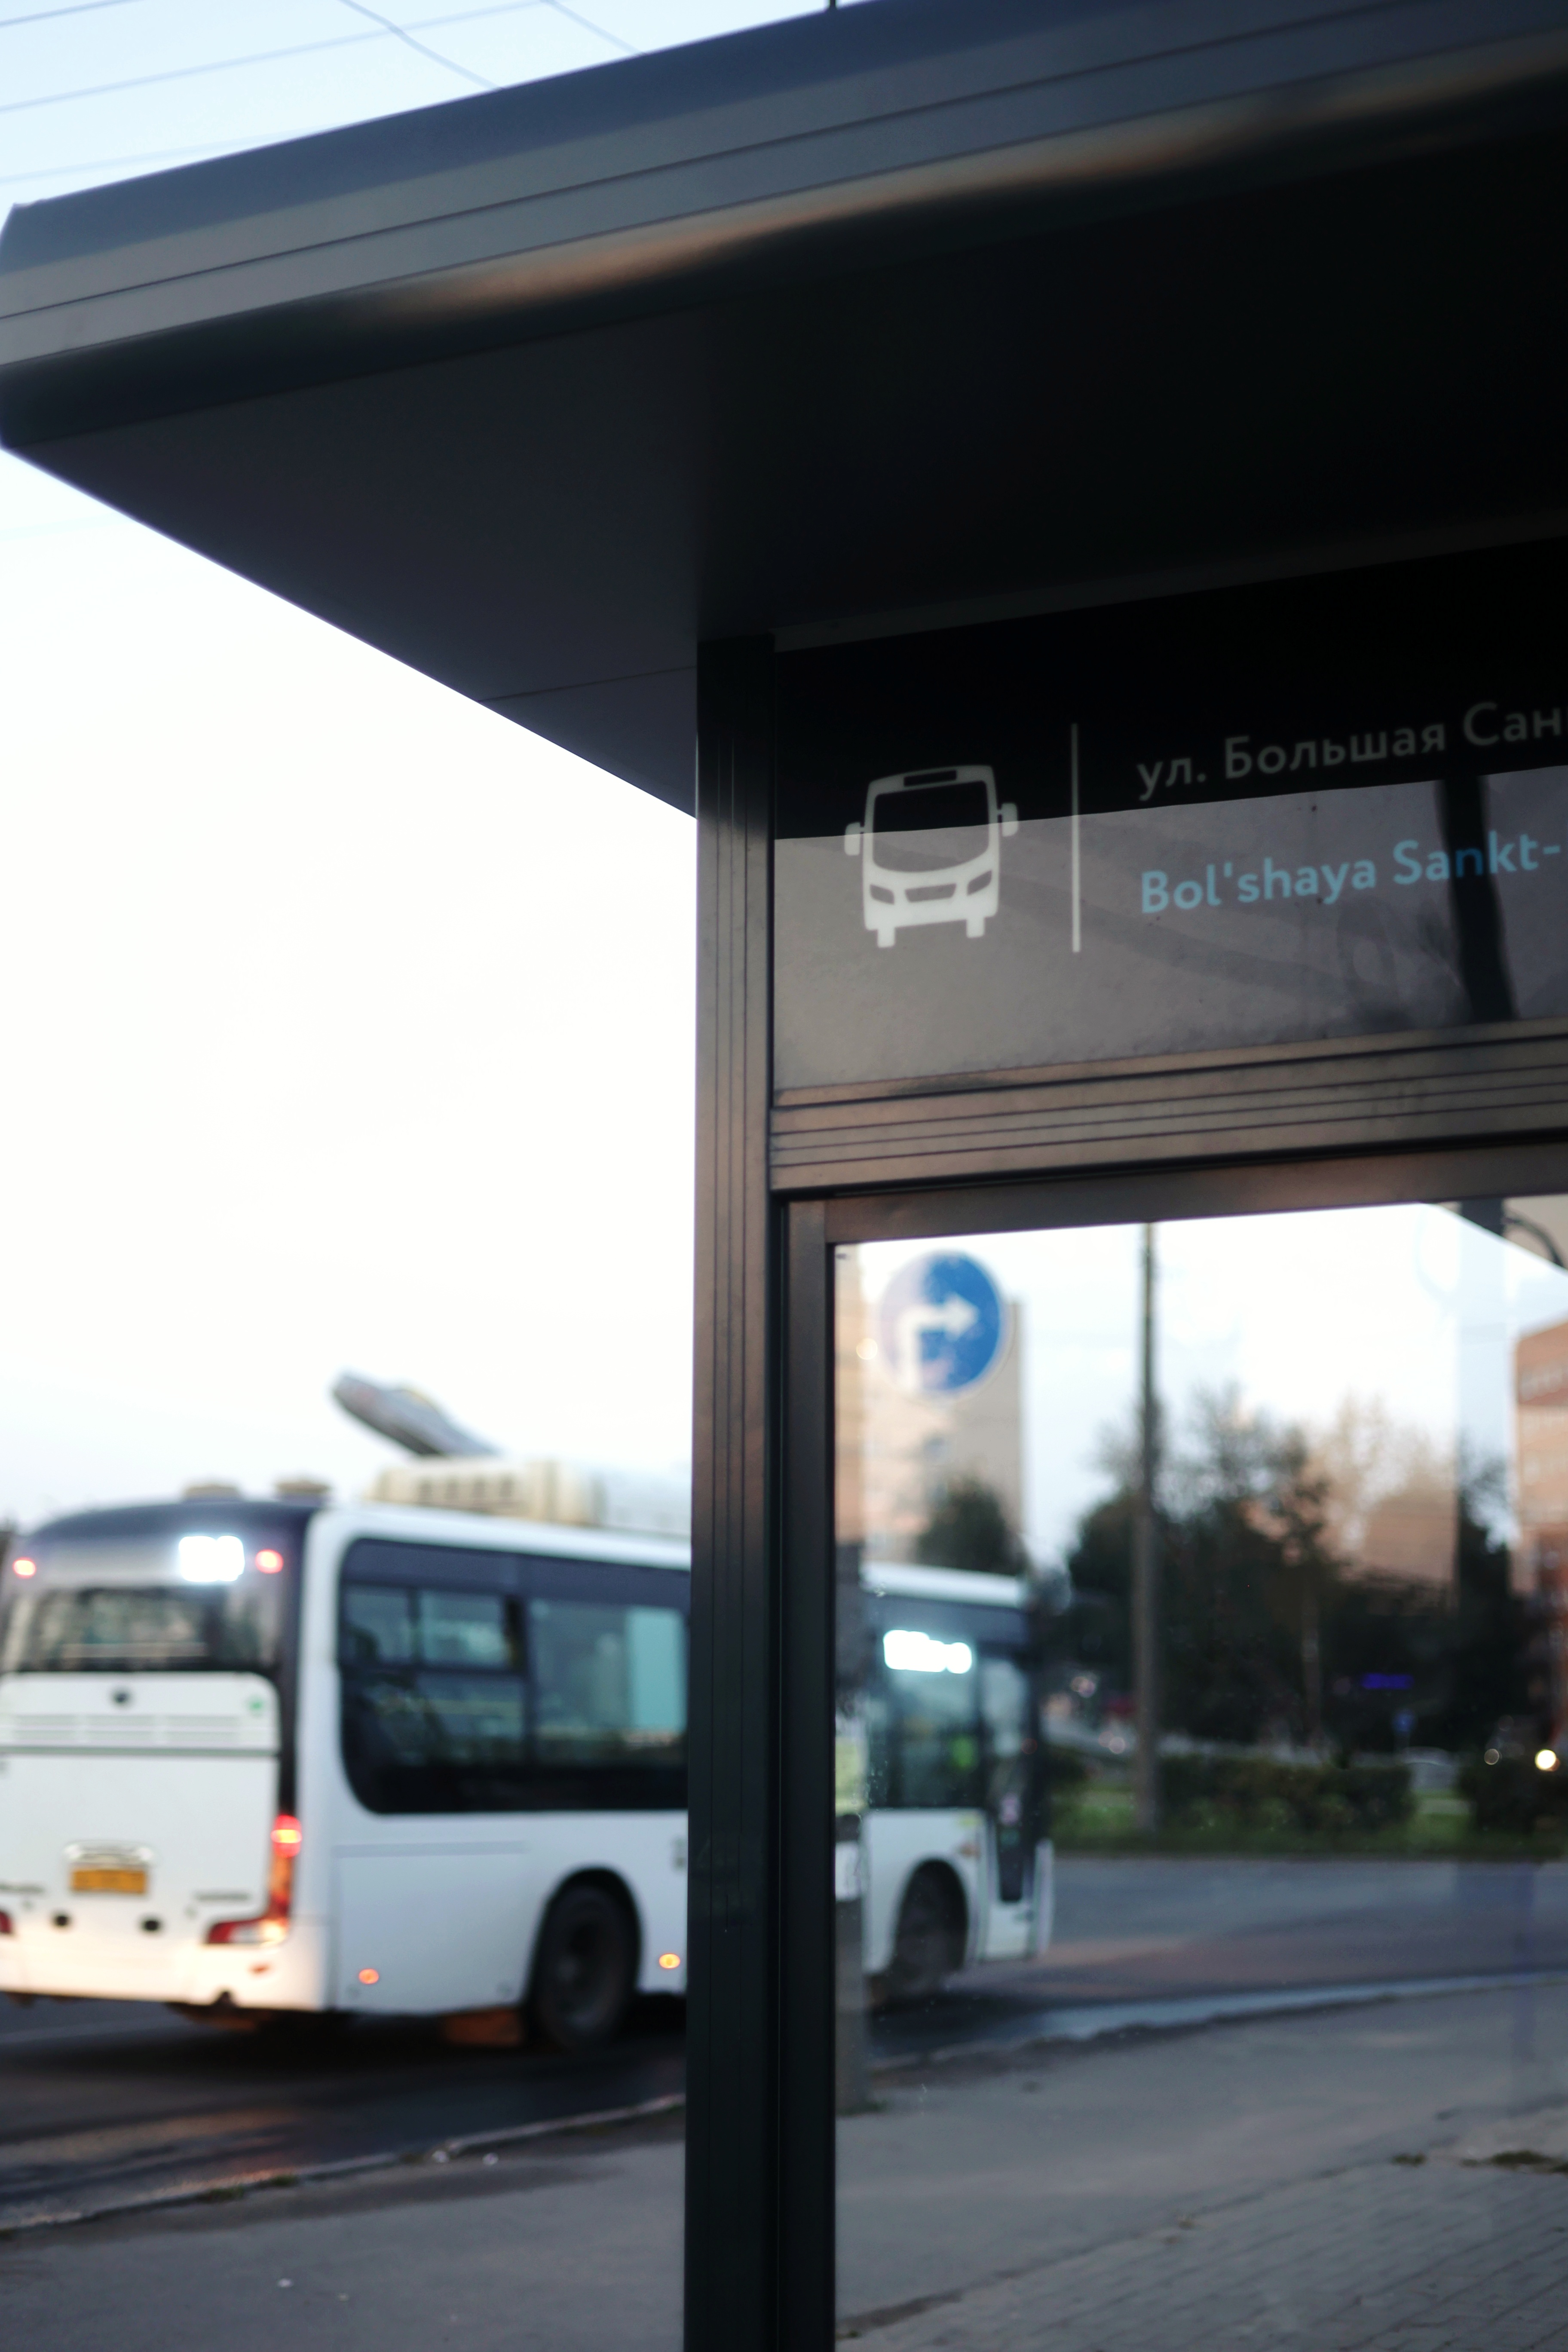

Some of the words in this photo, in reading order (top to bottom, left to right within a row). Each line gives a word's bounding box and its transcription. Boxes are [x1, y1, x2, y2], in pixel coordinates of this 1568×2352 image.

[1137, 757, 1207, 800] ул.
[1225, 723, 1446, 779] Большая
[1463, 701, 1568, 746] Сан
[1142, 857, 1376, 914] Bol'shaya
